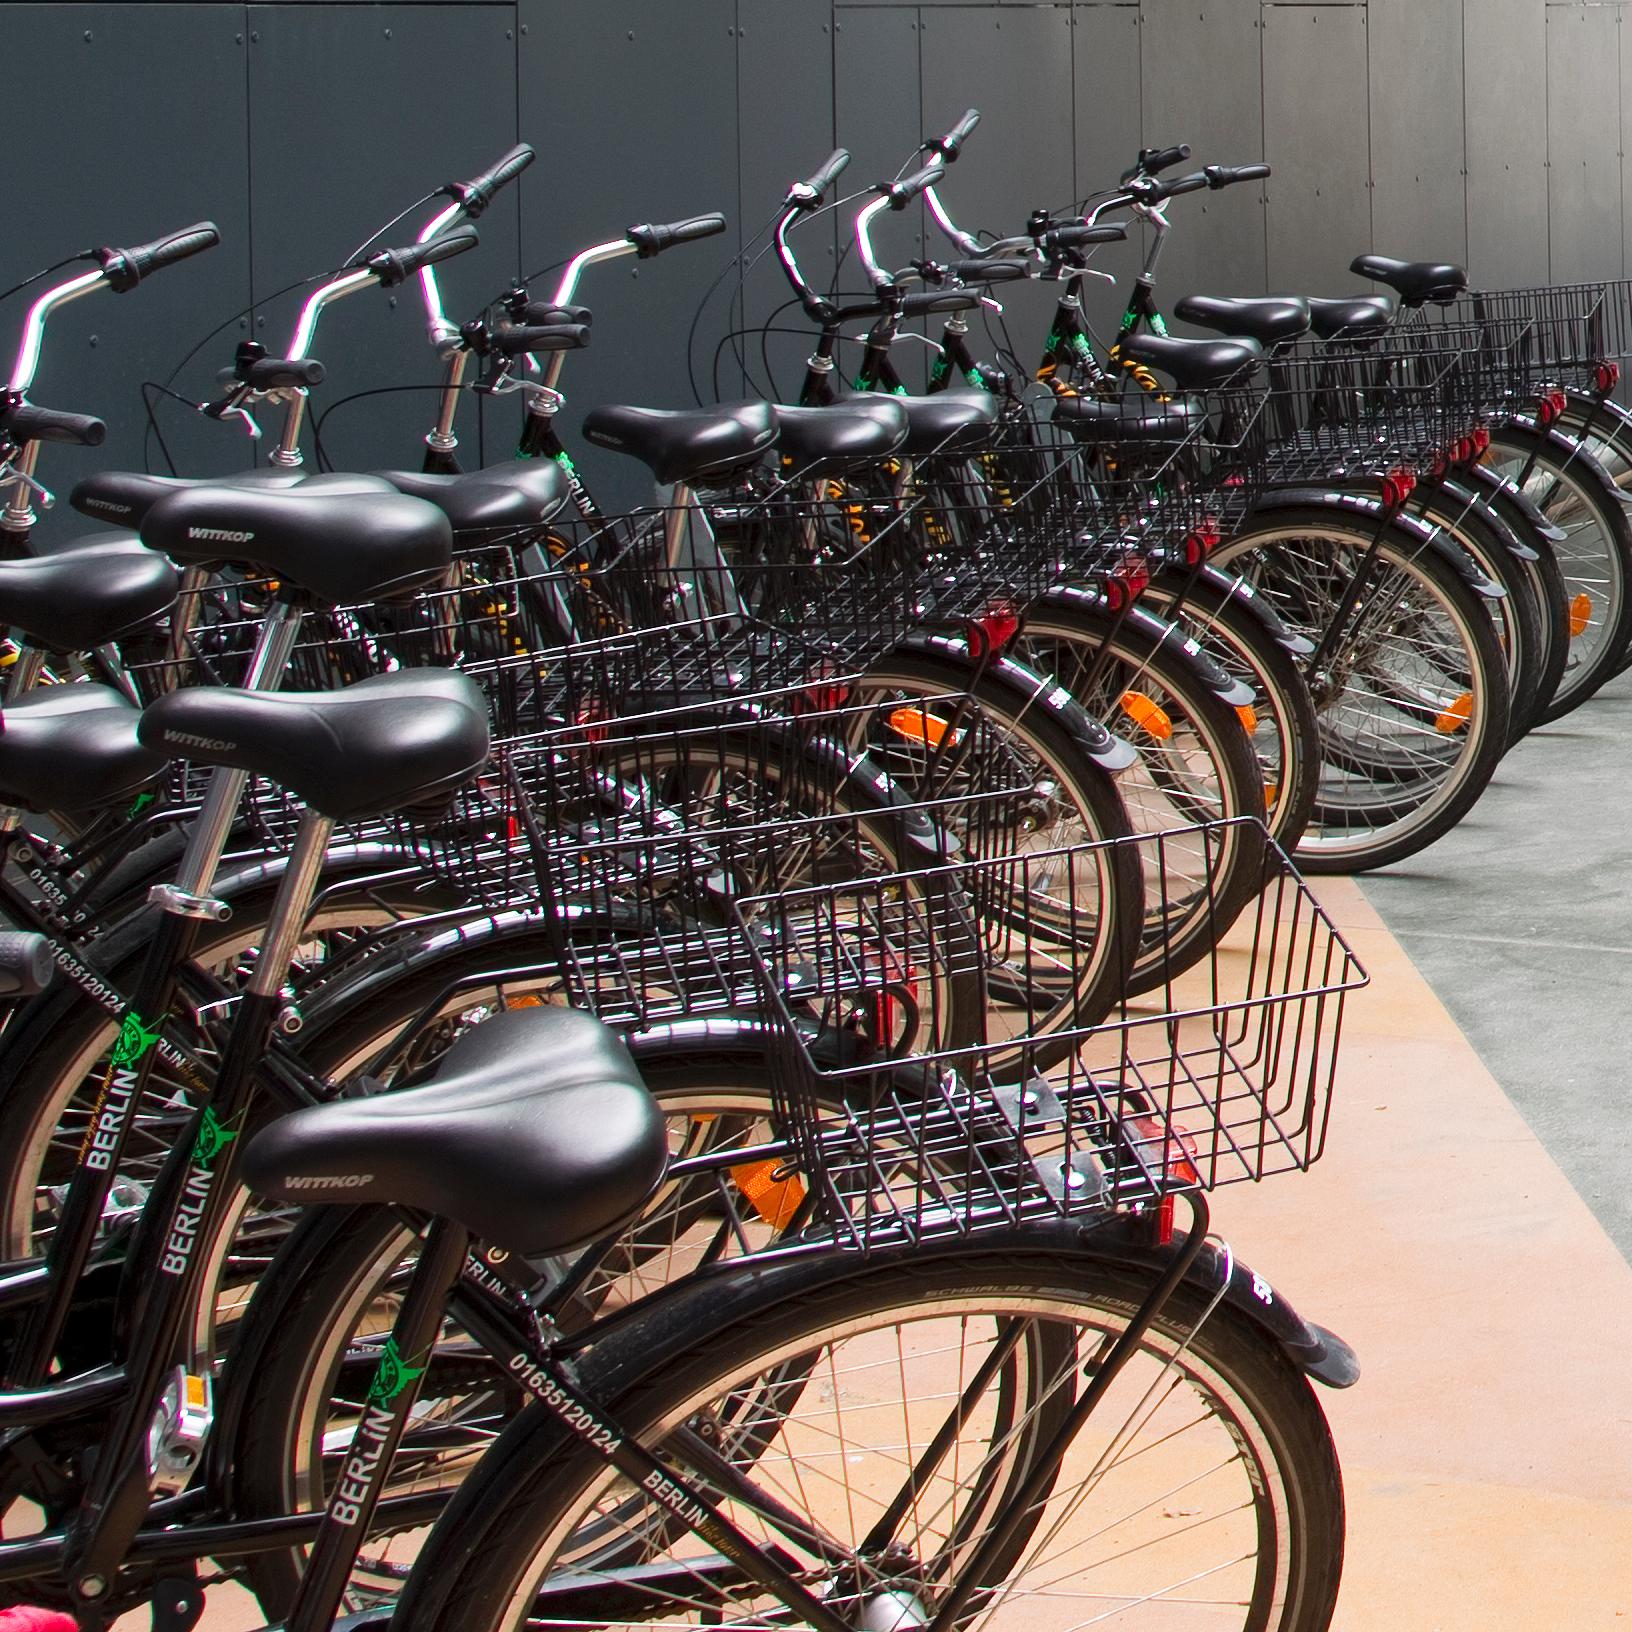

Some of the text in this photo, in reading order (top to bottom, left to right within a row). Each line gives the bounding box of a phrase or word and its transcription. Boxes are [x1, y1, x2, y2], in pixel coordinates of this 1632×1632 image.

[86, 497, 132, 514] WITTKOP
[188, 527, 255, 543] WITTKOP
[163, 729, 237, 751] WITTKOP
[48, 939, 128, 1014] 01635120124
[158, 1037, 187, 1068] RLIN
[86, 1068, 139, 1170] BERLIN
[285, 1174, 374, 1189] WITTKOP
[162, 1168, 215, 1275] BERLIN
[465, 1251, 508, 1298] ERLIN
[509, 1352, 623, 1455] 01635120124
[331, 1406, 396, 1526] BERLIN
[642, 1469, 710, 1528] BERLIN
